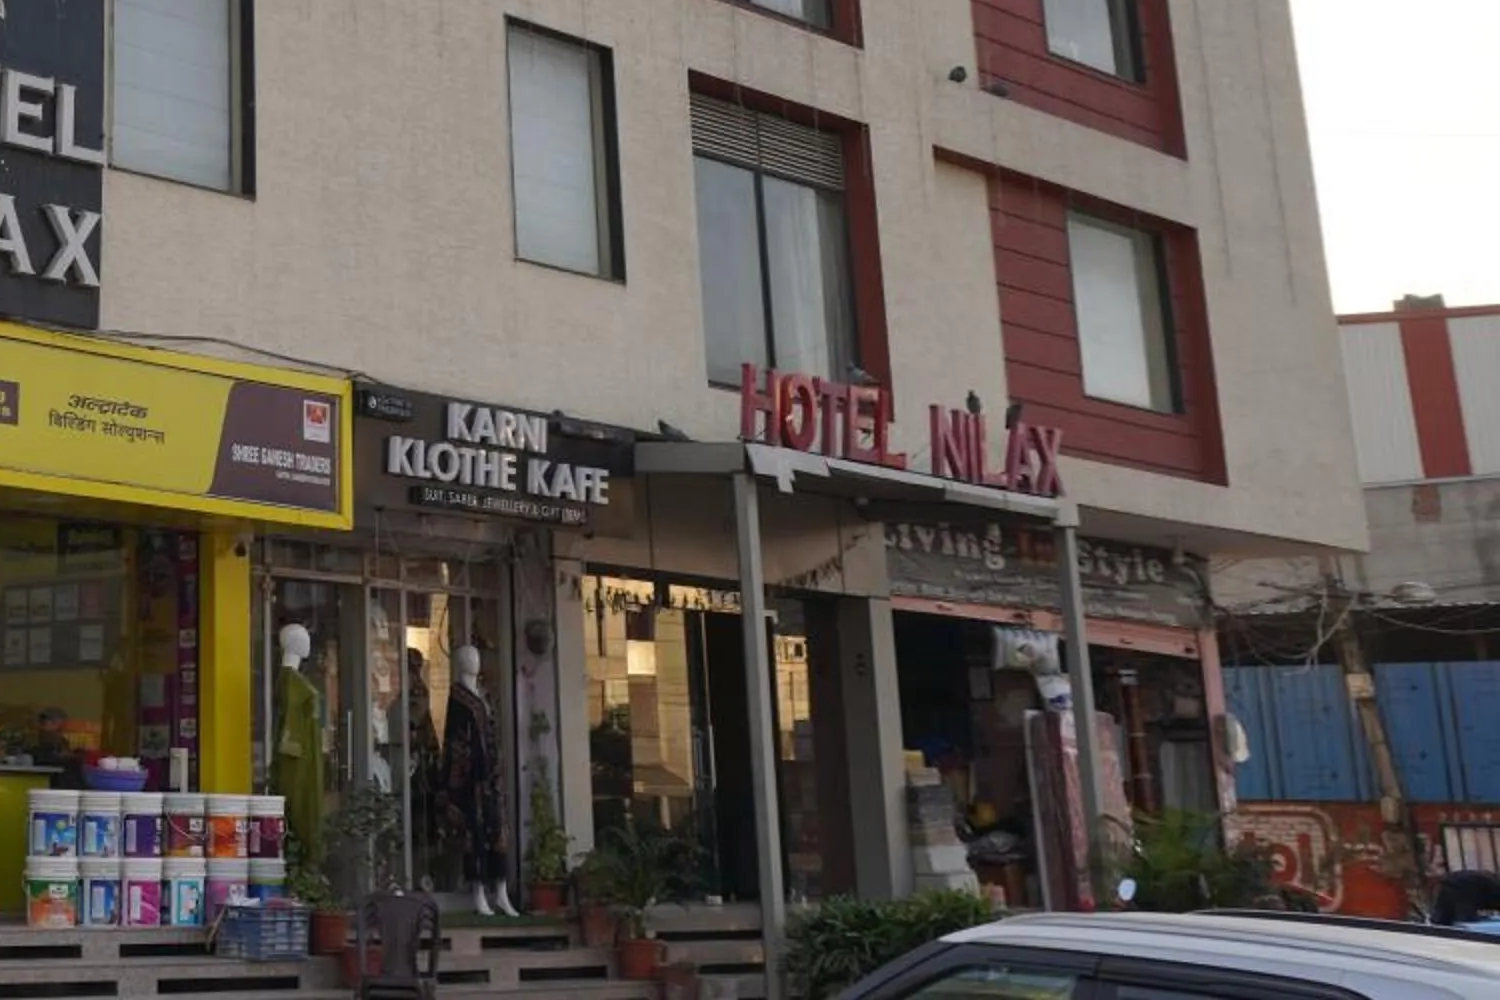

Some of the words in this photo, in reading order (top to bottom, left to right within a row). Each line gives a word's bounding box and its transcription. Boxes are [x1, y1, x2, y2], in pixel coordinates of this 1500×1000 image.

[231, 443, 260, 463] SHREE
[446, 401, 548, 453] KARNI
[741, 363, 907, 470] HOTEL
[929, 404, 1066, 498] NILAX
[387, 436, 517, 491] KLOTHE
[526, 458, 610, 505] KAFE
[1077, 537, 1165, 584] Style
